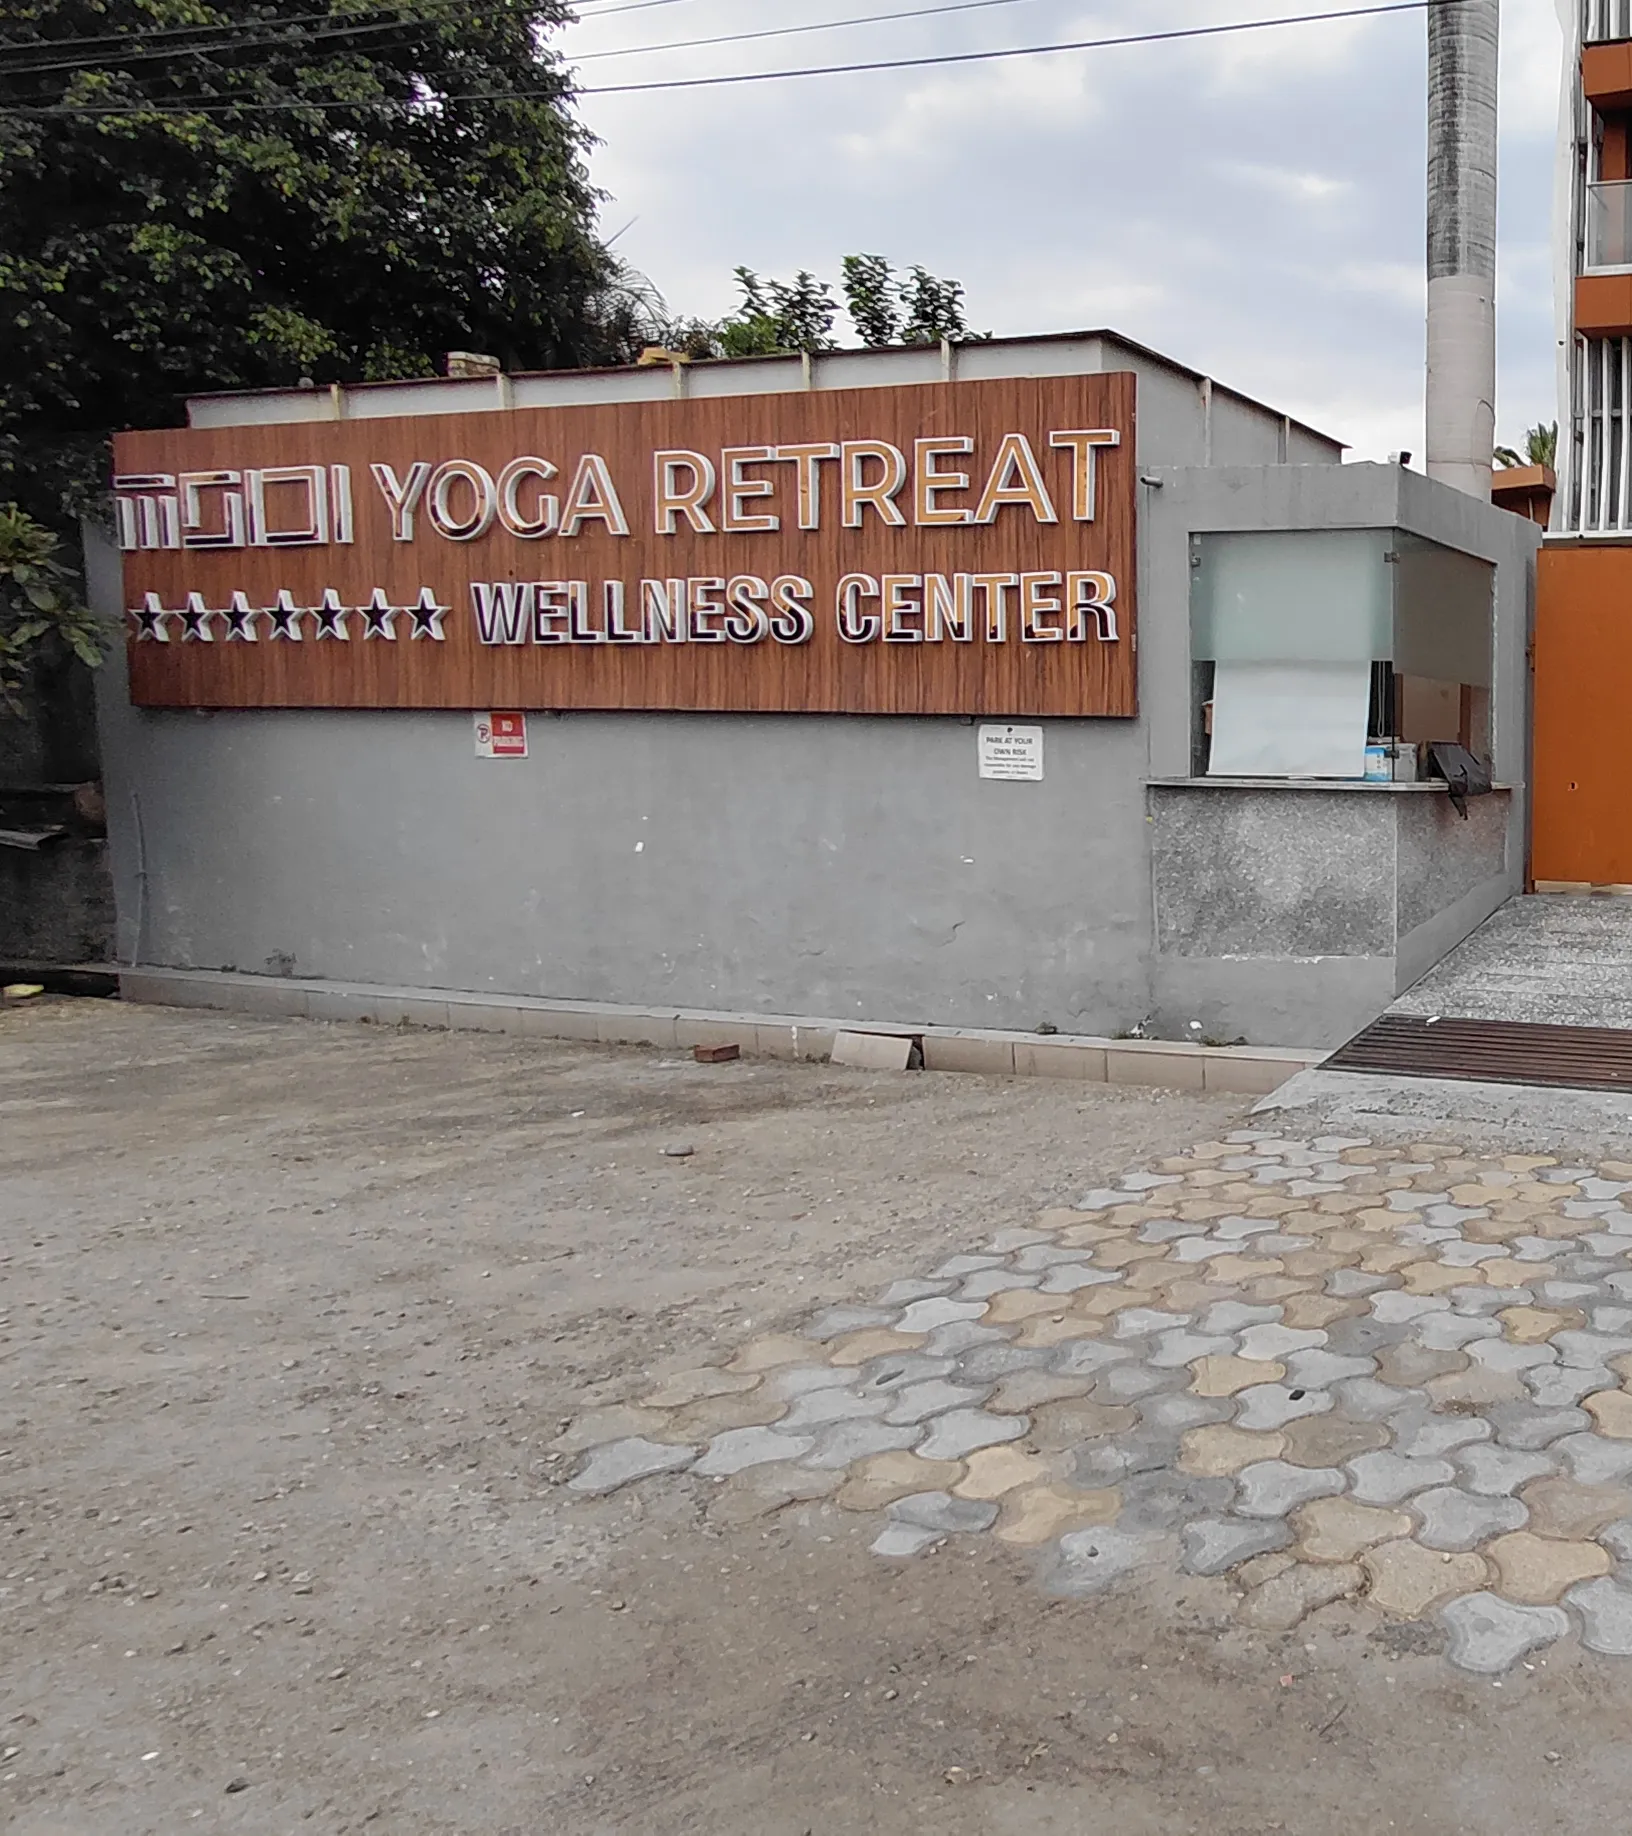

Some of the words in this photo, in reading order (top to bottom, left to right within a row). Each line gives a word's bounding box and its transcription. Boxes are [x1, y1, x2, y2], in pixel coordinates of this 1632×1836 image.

[368, 453, 631, 542] YOGA
[653, 428, 1121, 534] RETREAT
[470, 574, 814, 645] WELLNESS
[836, 570, 1120, 644] CENTER
[1014, 737, 1033, 745] YOUR
